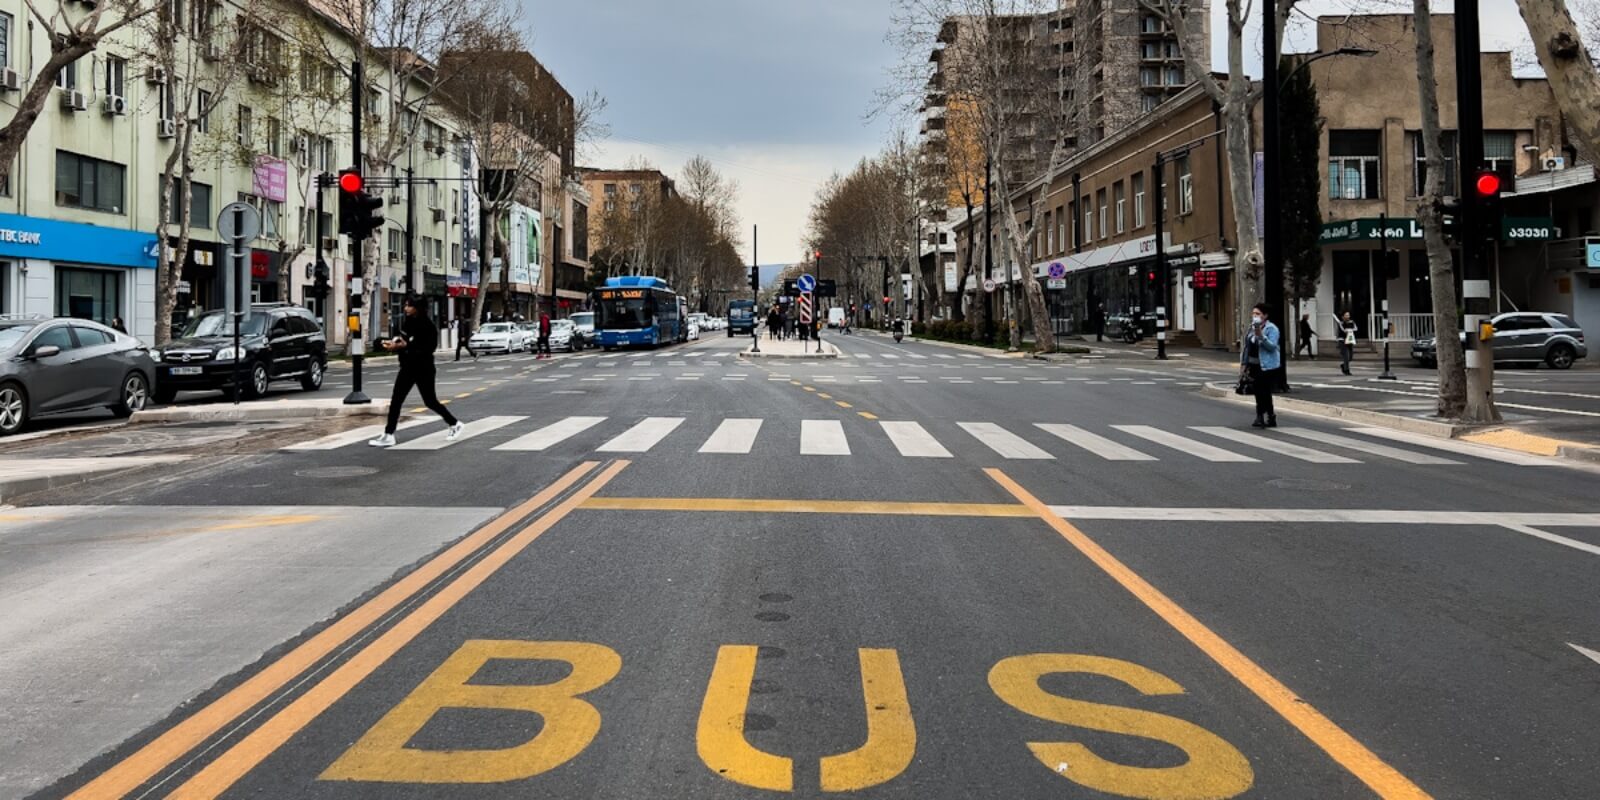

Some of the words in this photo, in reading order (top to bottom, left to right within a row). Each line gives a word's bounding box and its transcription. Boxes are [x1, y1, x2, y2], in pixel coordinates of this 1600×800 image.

[0, 229, 17, 242] TBC
[18, 231, 41, 245] BANK
[315, 639, 1256, 800] BUS
